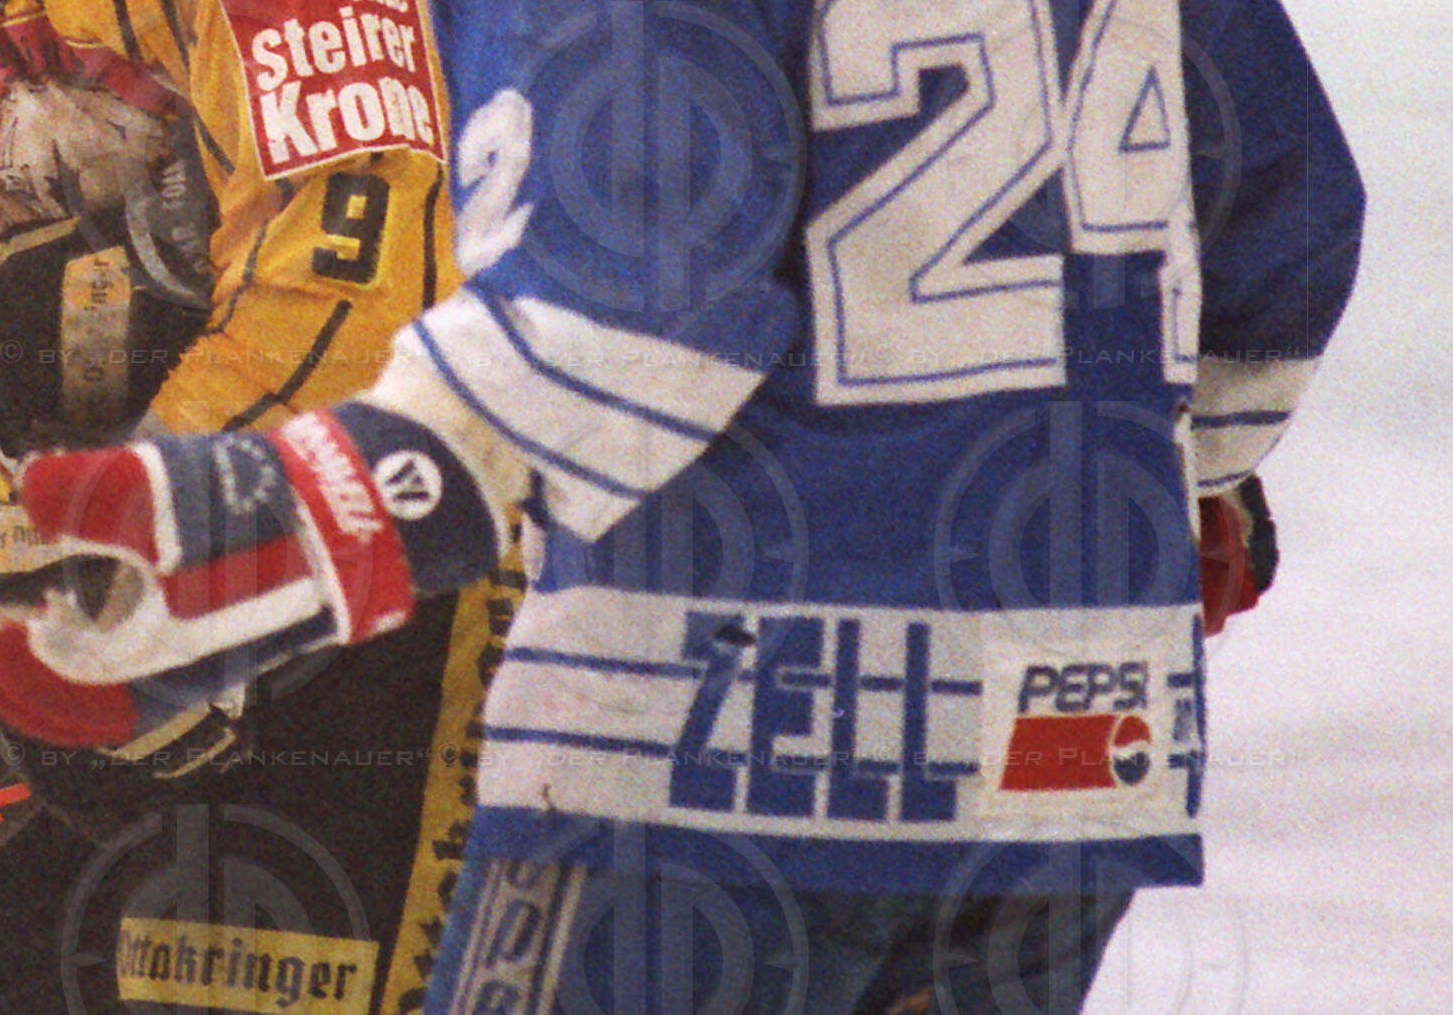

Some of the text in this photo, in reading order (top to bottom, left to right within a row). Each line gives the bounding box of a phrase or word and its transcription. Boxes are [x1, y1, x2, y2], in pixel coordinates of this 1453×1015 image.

[252, 6, 416, 92] steirer
[259, 76, 435, 165] Krone
[311, 173, 390, 284] 9
[668, 611, 959, 823] ZELL
